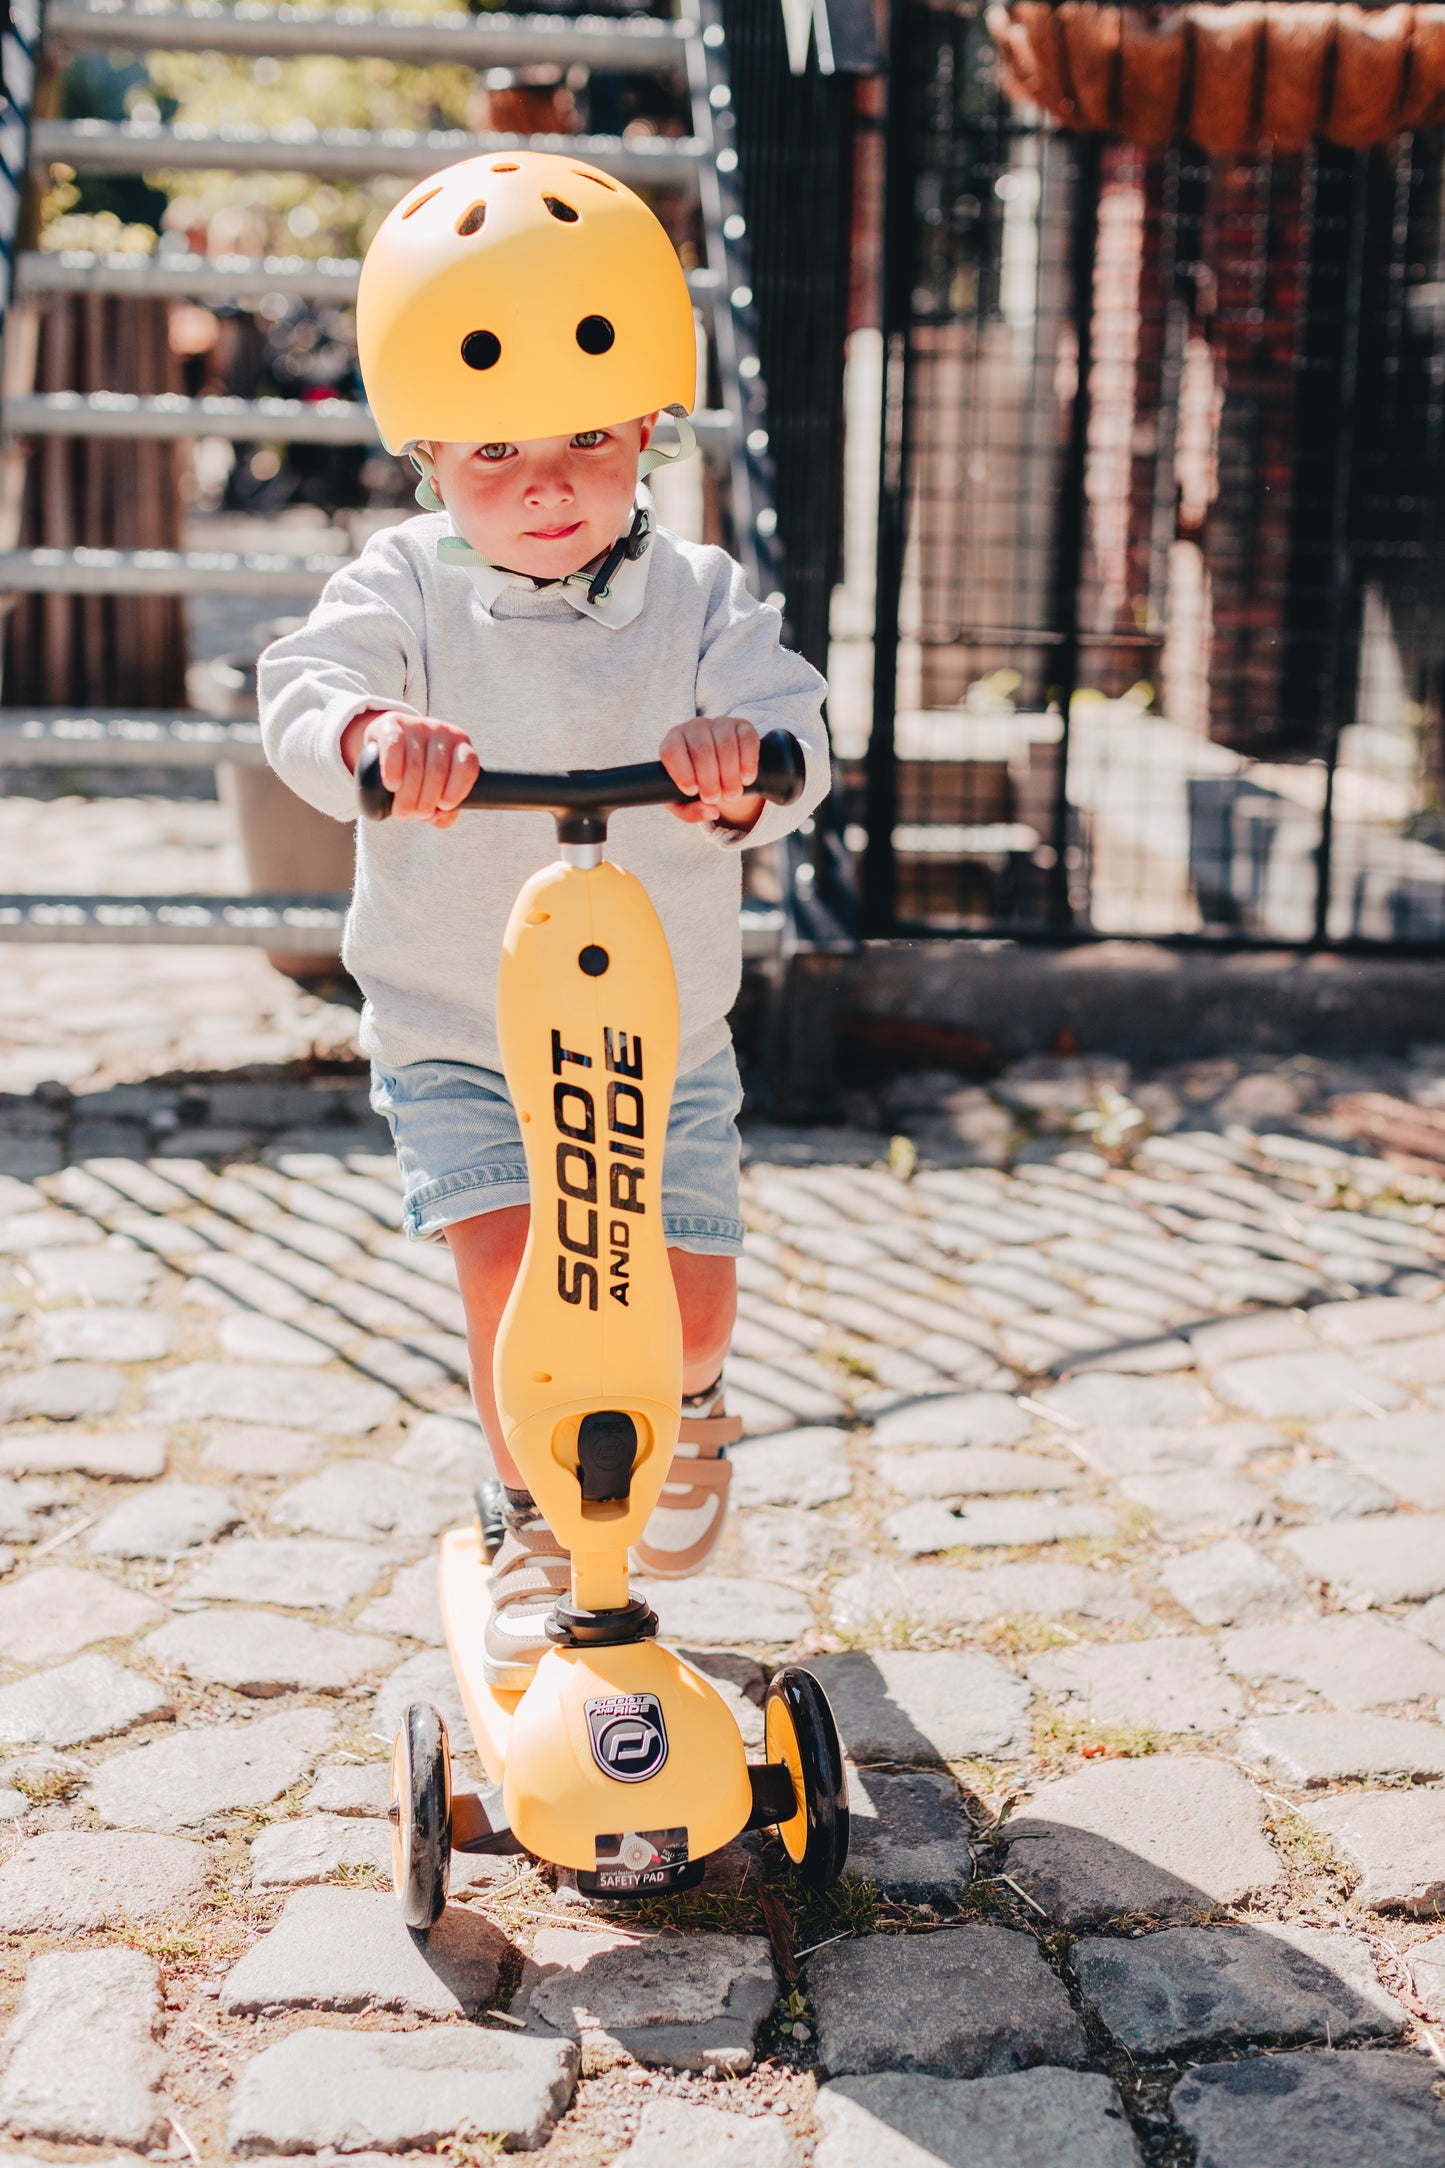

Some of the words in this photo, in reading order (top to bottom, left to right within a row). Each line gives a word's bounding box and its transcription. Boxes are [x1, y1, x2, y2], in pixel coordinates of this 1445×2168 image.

[603, 1026, 645, 1214] RIDE
[551, 1028, 598, 1311] SCOOT
[610, 1220, 629, 1307] AND
[595, 1696, 648, 1707] SCOOT
[595, 1708, 615, 1716] AND
[615, 1705, 650, 1716] RIDE
[600, 1875, 641, 1887] SAFETY
[643, 1872, 665, 1884] PAD
